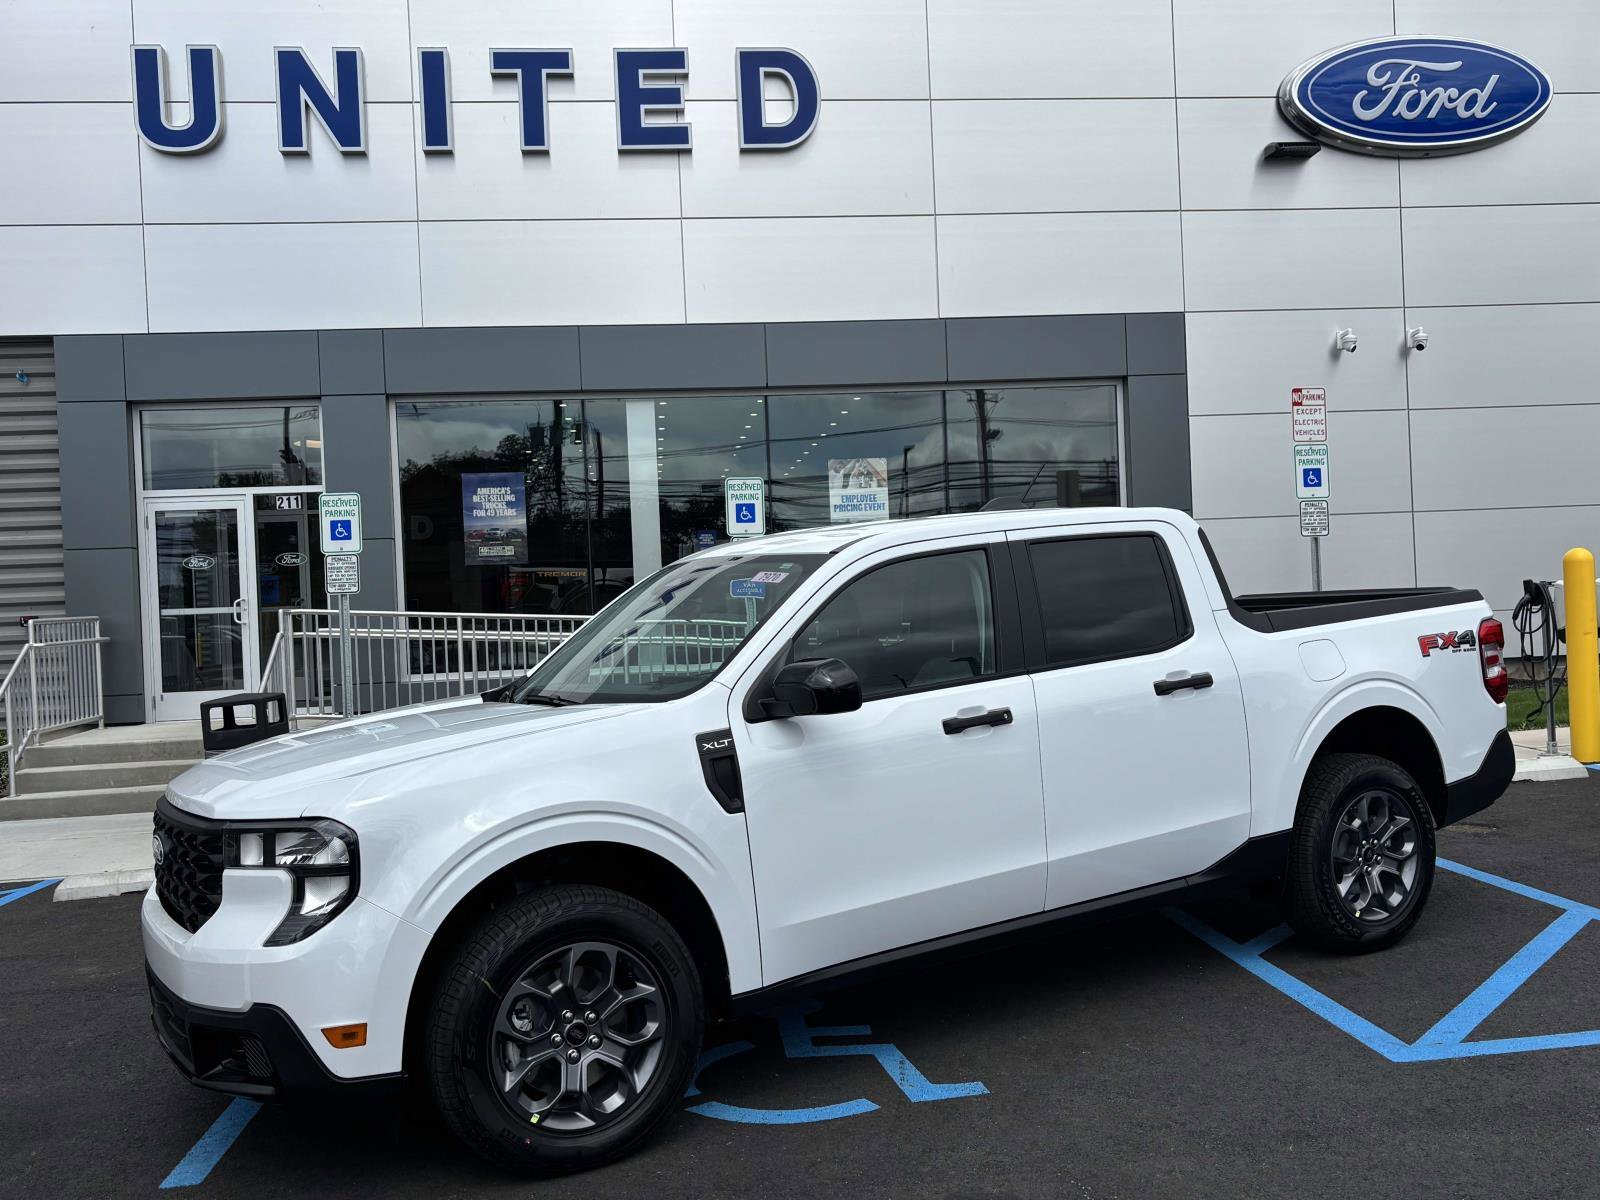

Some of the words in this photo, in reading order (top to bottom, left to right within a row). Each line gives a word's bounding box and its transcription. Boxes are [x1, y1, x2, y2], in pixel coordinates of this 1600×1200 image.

[1352, 58, 1500, 122] Ford
[130, 44, 822, 156] UNITED
[1293, 392, 1302, 402] NO
[1302, 393, 1325, 402] PARKING
[1296, 448, 1327, 457] RESERVED
[1298, 458, 1325, 466] PARKING
[477, 487, 511, 495] AMERICA'S
[728, 483, 761, 491] RESERVED
[472, 494, 516, 503] BEST-SELLING
[730, 493, 760, 501] PARKING
[841, 494, 878, 503] EMPLOYEE
[277, 496, 300, 509] 211
[322, 499, 358, 508] RESERVED
[833, 503, 863, 512] PRICING
[863, 502, 886, 511] EVENT
[324, 509, 356, 518] PARKING
[473, 509, 486, 517] FOR
[486, 509, 495, 517] 49
[496, 508, 517, 517] YEARS
[188, 556, 209, 567] Ford
[282, 554, 302, 564] Ford
[1418, 630, 1476, 657] FX4
[701, 738, 733, 751] XLT
